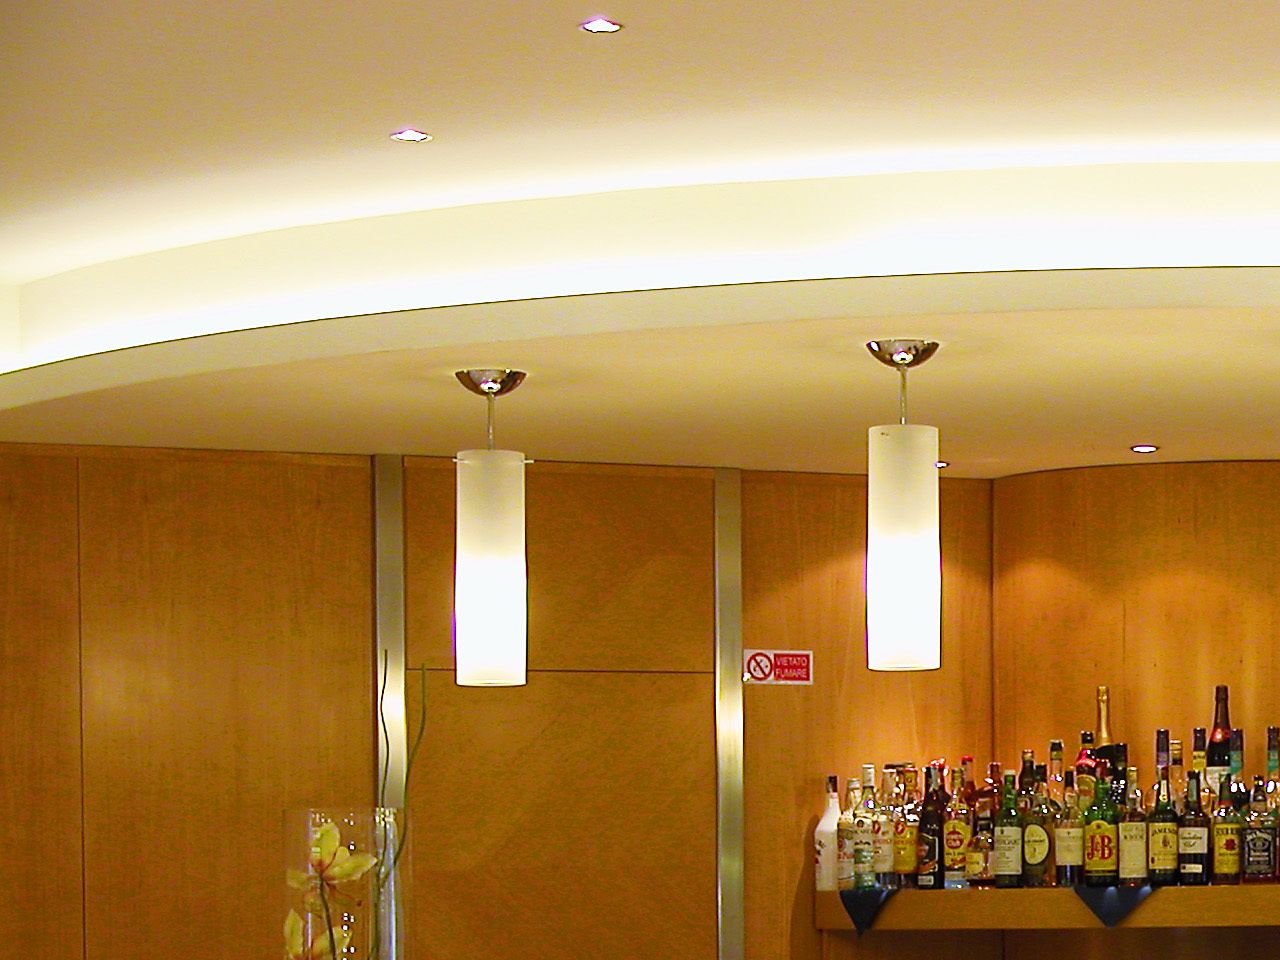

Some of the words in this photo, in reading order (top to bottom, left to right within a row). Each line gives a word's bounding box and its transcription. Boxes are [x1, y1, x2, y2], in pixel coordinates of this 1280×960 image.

[775, 656, 808, 667] VIETATO
[775, 668, 808, 679] FUMARE
[1086, 834, 1113, 862] J&B
